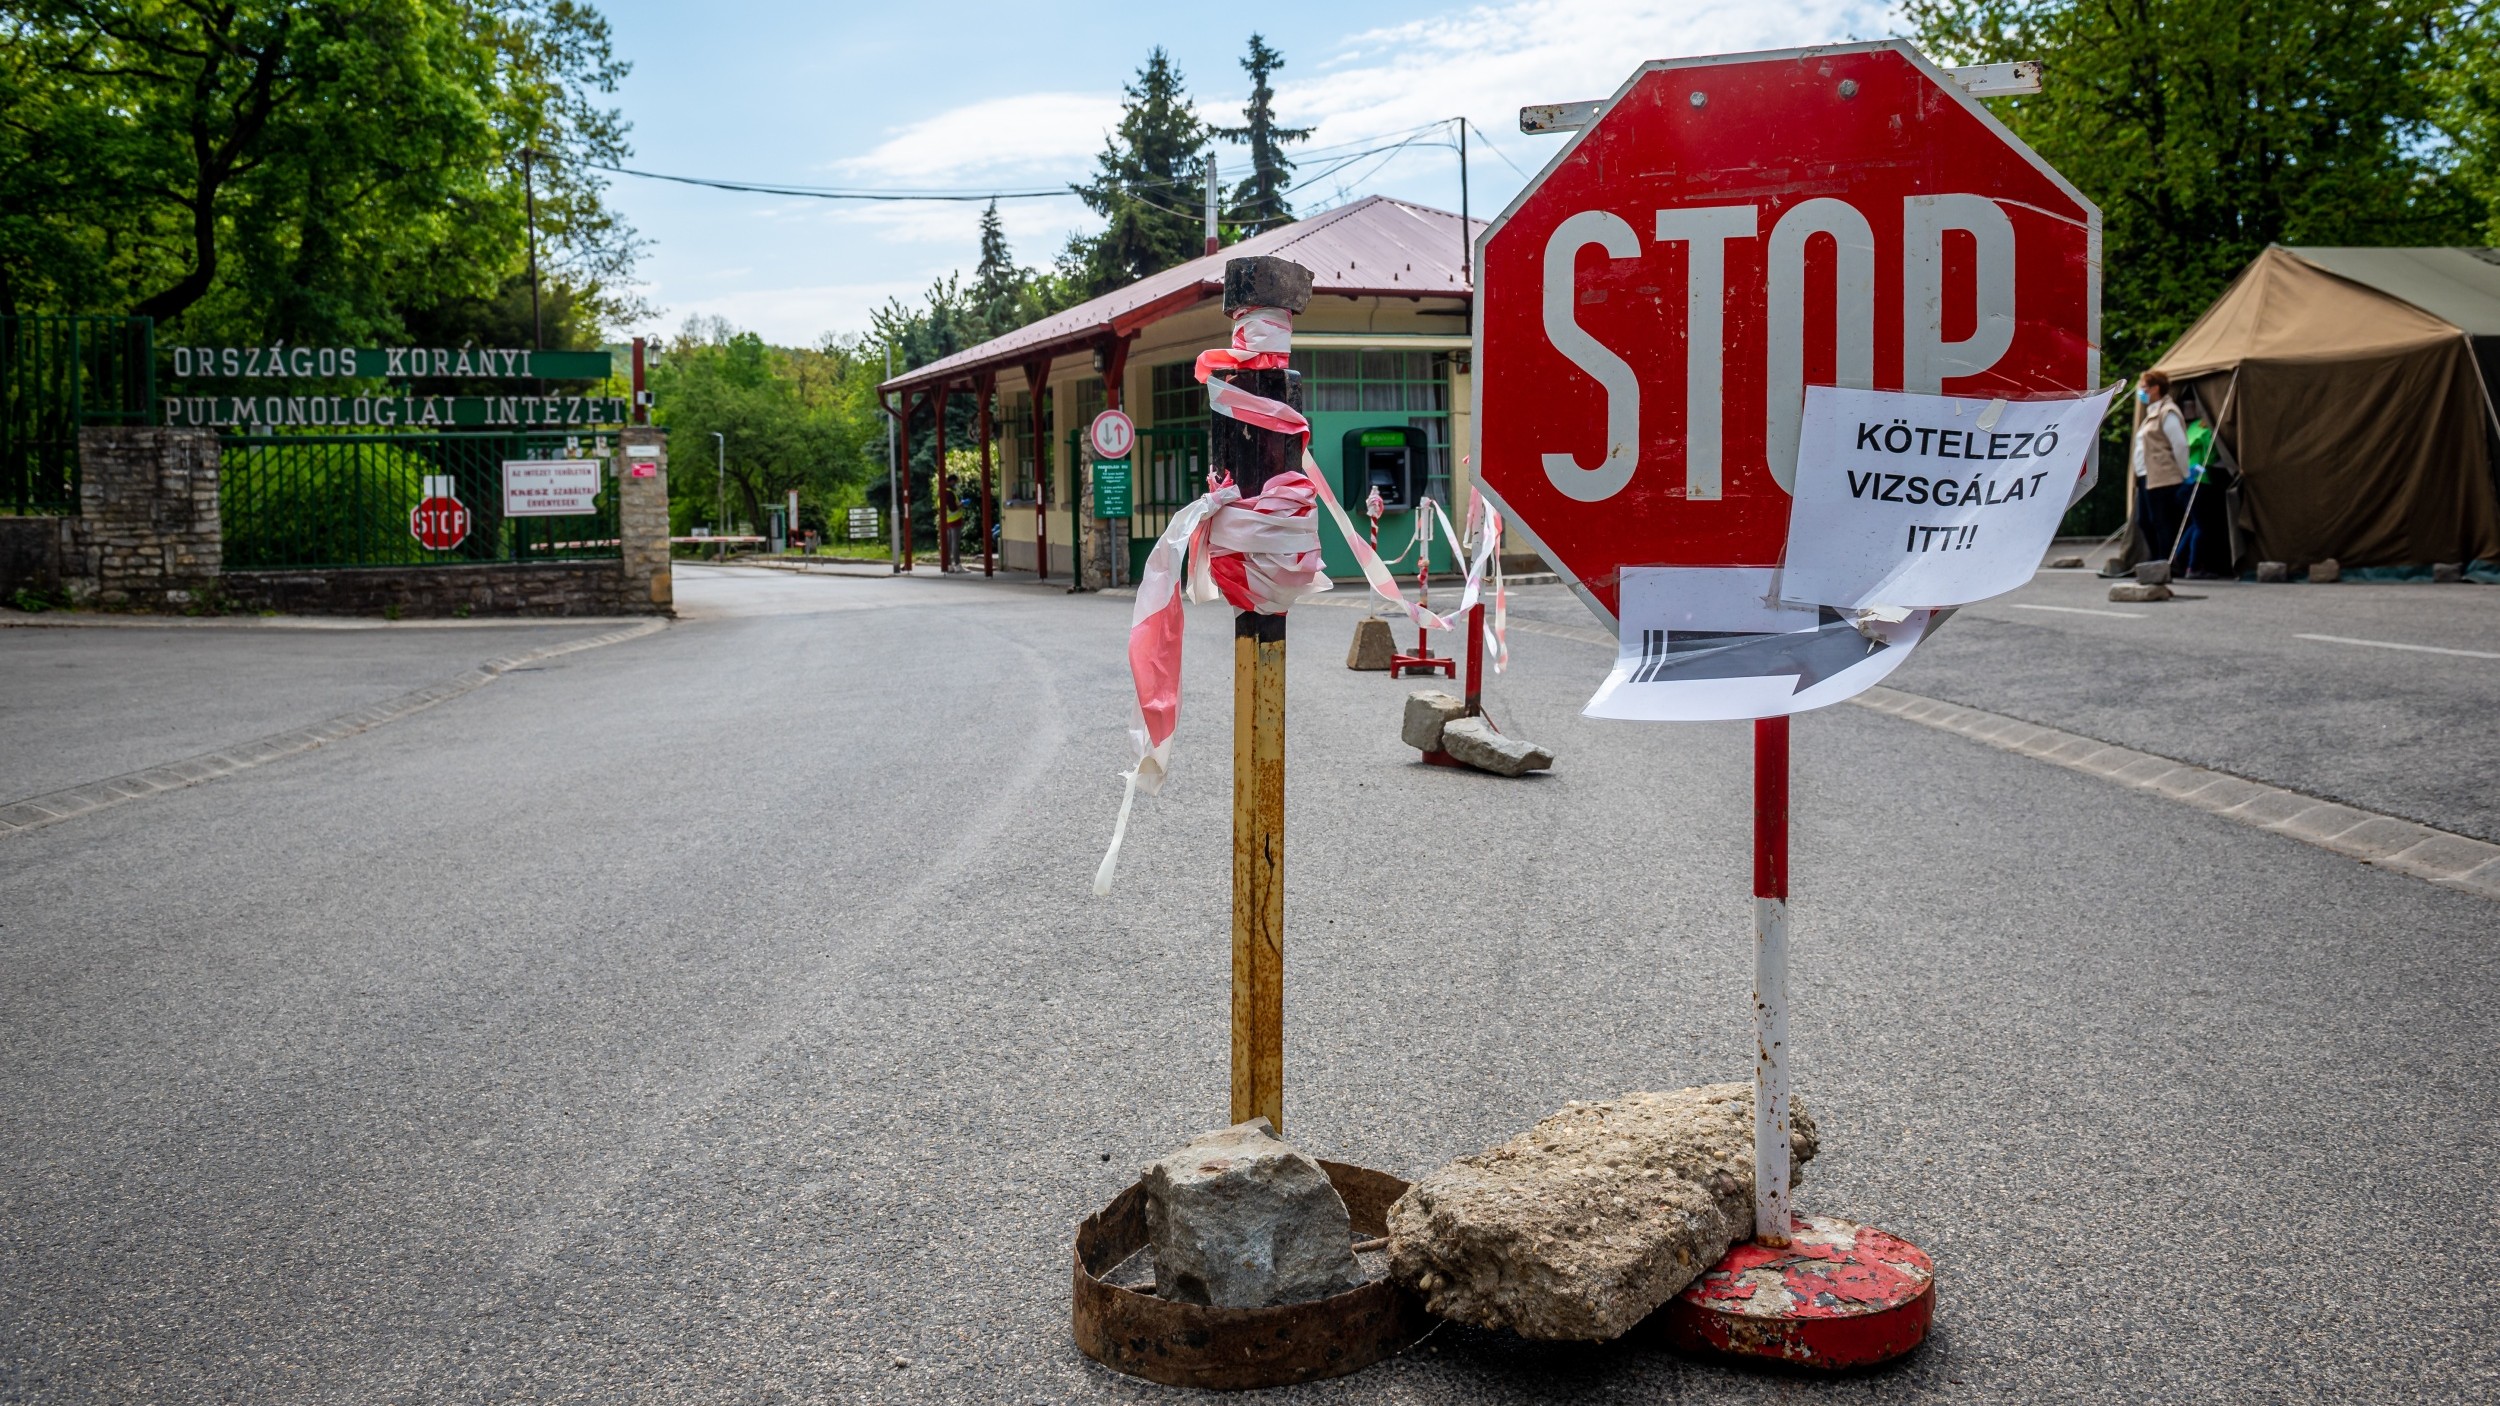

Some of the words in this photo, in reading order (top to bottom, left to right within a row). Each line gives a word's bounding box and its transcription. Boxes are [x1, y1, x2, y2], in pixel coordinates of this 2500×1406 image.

[174, 339, 357, 377] ORSZÁGOS
[385, 340, 532, 377] KORÁNYI
[1541, 193, 2016, 502] STOP
[164, 389, 456, 426] PULMONOLÓGIAI
[484, 389, 626, 425] INTÉZET
[1857, 419, 2059, 460] KÖTELEZŐ
[1847, 470, 2048, 507] VIZSGÁLAT
[416, 510, 464, 534] STOP
[1906, 524, 1979, 553] ITT!!
